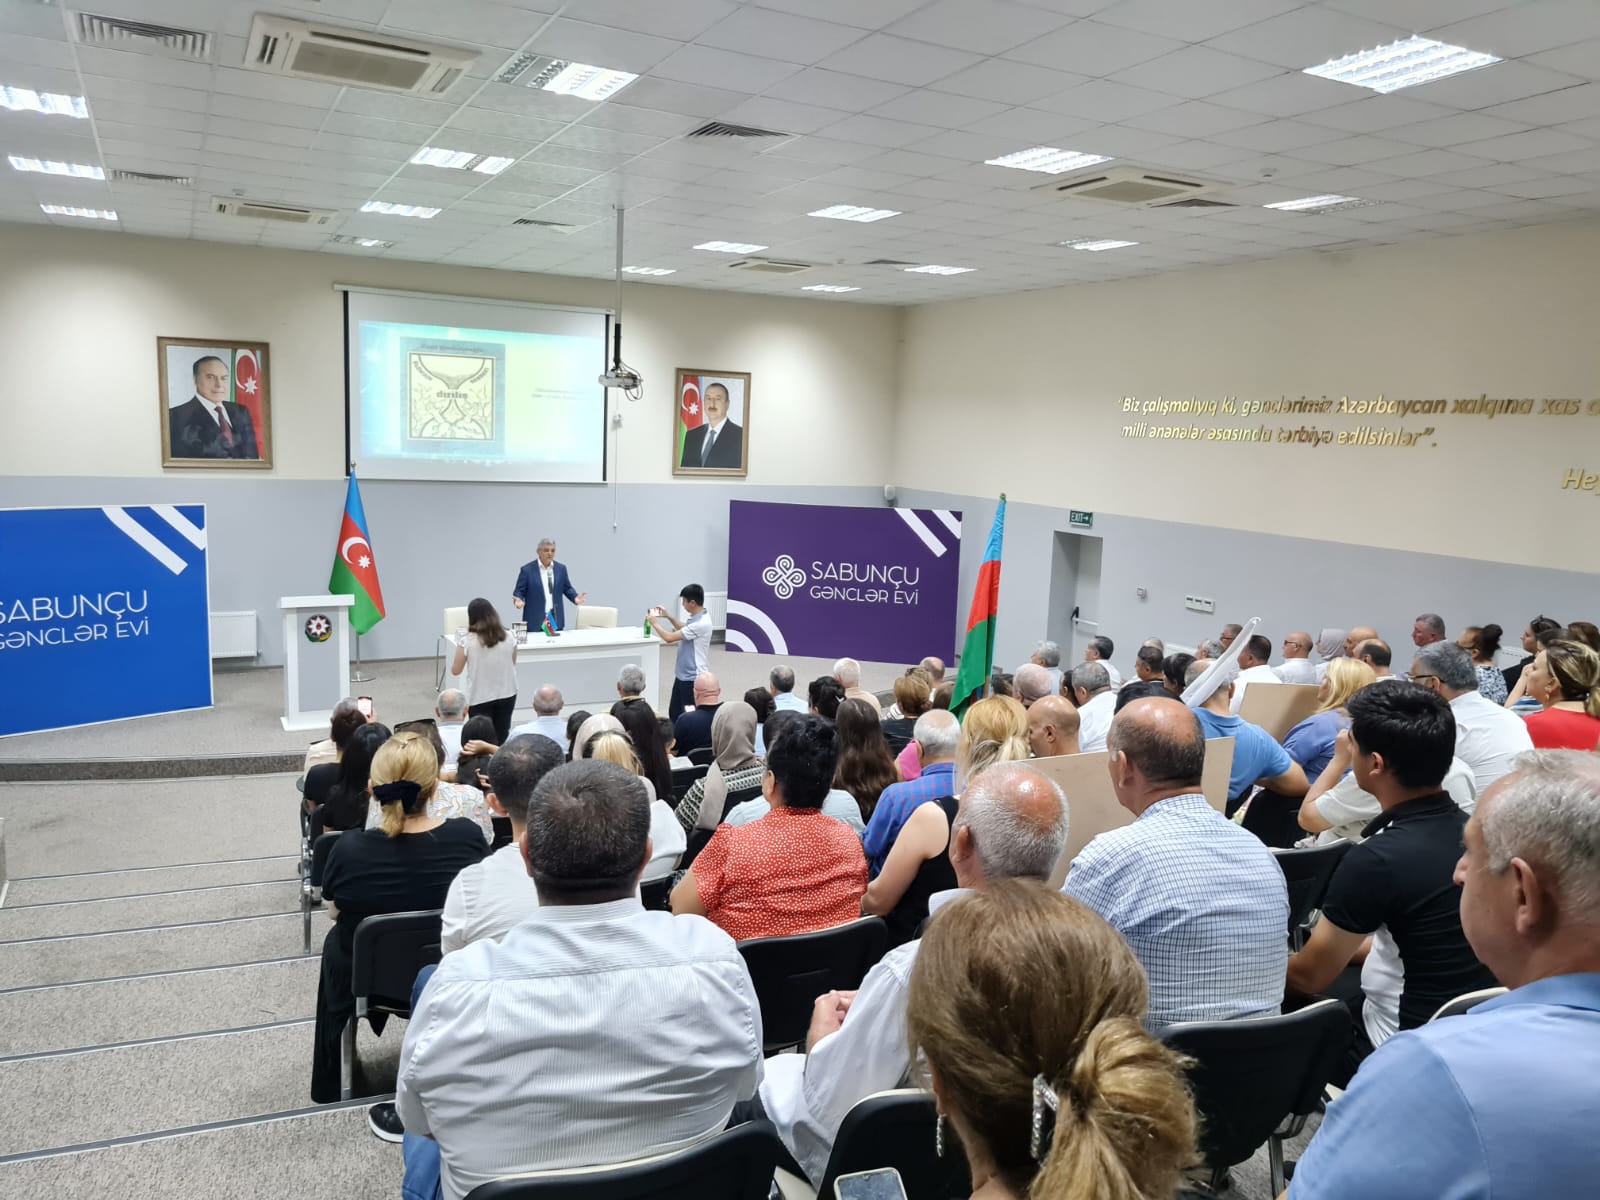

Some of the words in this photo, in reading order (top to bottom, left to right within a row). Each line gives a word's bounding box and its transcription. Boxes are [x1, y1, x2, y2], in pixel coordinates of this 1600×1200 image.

[1142, 396, 1218, 416] çalışmalıyıq
[1221, 396, 1237, 416] ki,
[1241, 395, 1333, 416] gənclərimiz
[1336, 394, 1447, 418] Azərbaycan
[1450, 393, 1534, 420] xalqına
[1538, 398, 1582, 416] xas
[1121, 422, 1148, 438] milli
[1149, 423, 1206, 439] ənənələr
[1207, 425, 1272, 442] əsasında
[1276, 425, 1333, 447] tərbiyə
[1071, 512, 1084, 523] EXIT
[811, 561, 920, 589] SABUNÇU
[809, 585, 889, 603] GƏNCLƏR
[894, 588, 919, 605] EVİ
[115, 615, 149, 639] EVİ
